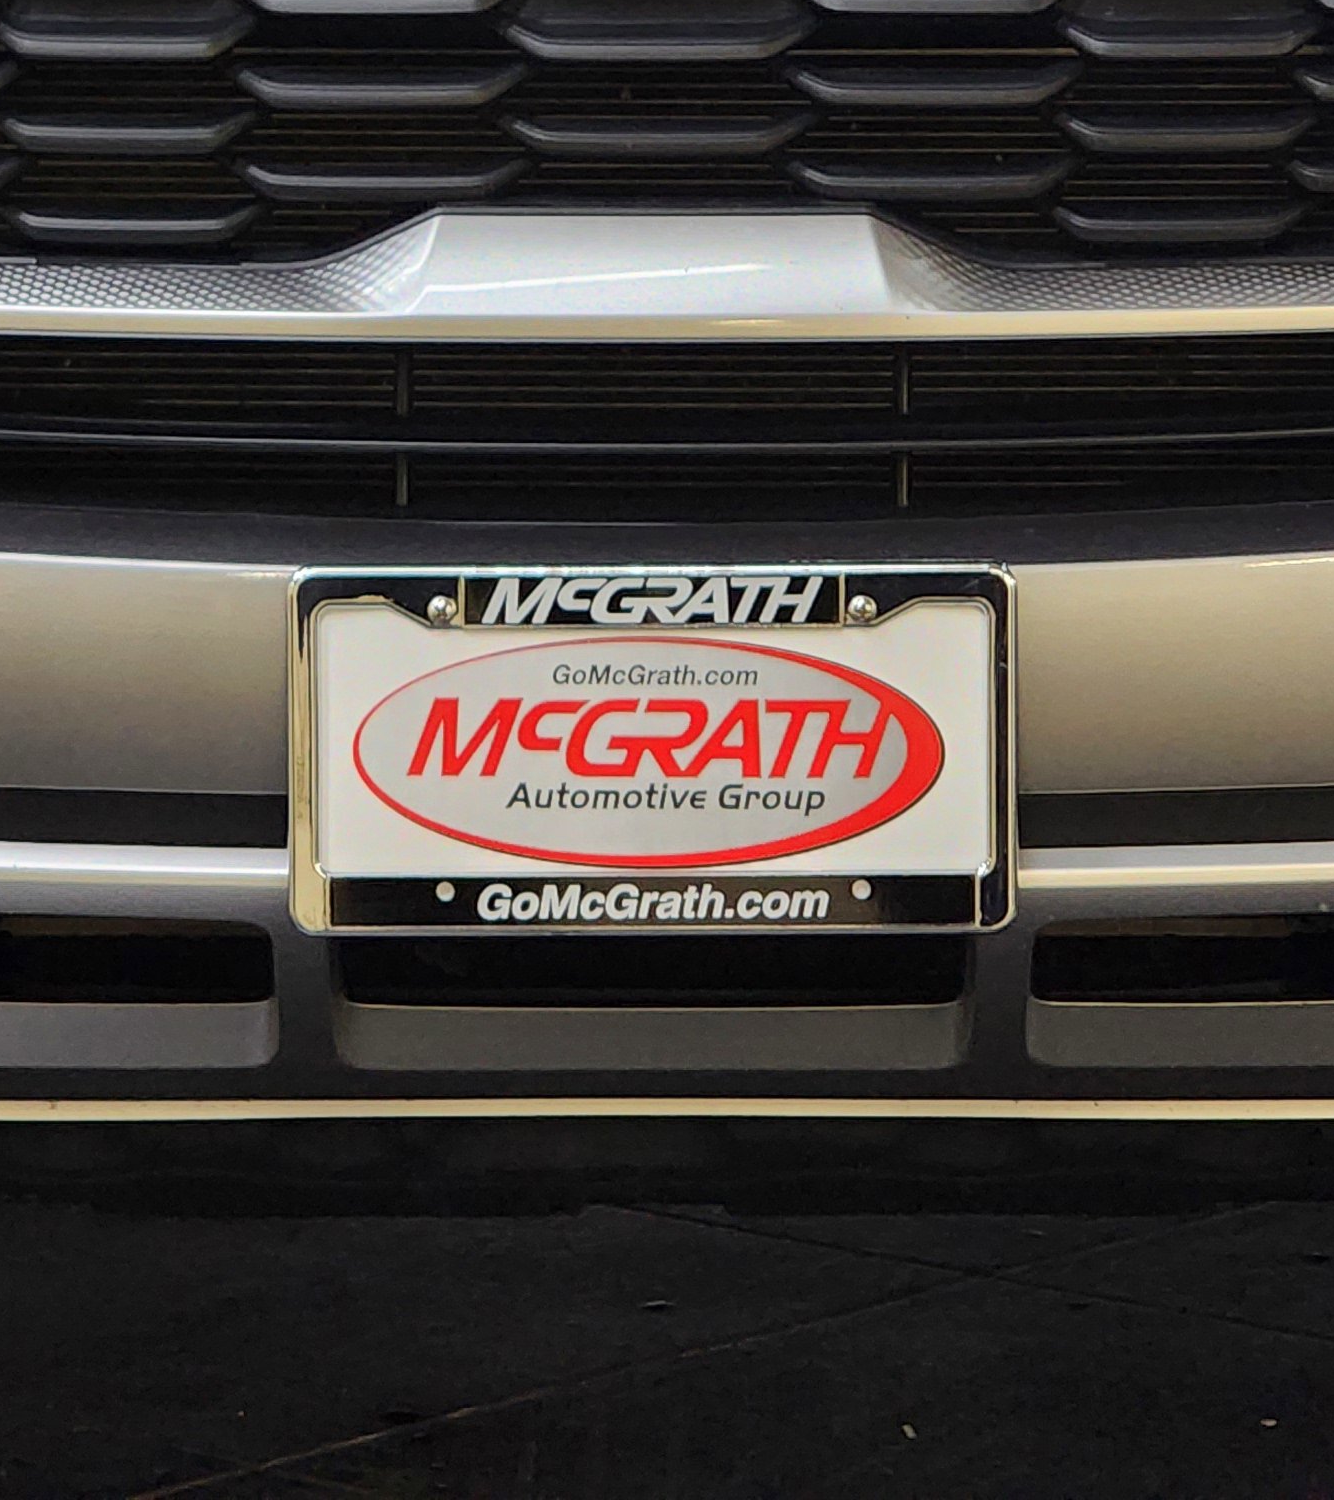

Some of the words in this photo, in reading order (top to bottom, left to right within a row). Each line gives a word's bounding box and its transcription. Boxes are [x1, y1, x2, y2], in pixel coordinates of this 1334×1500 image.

[552, 663, 758, 687] GoMcGrath.com
[506, 783, 706, 811] Automotive
[718, 783, 826, 816] Group
[476, 884, 828, 923] GoMcGrath.com
